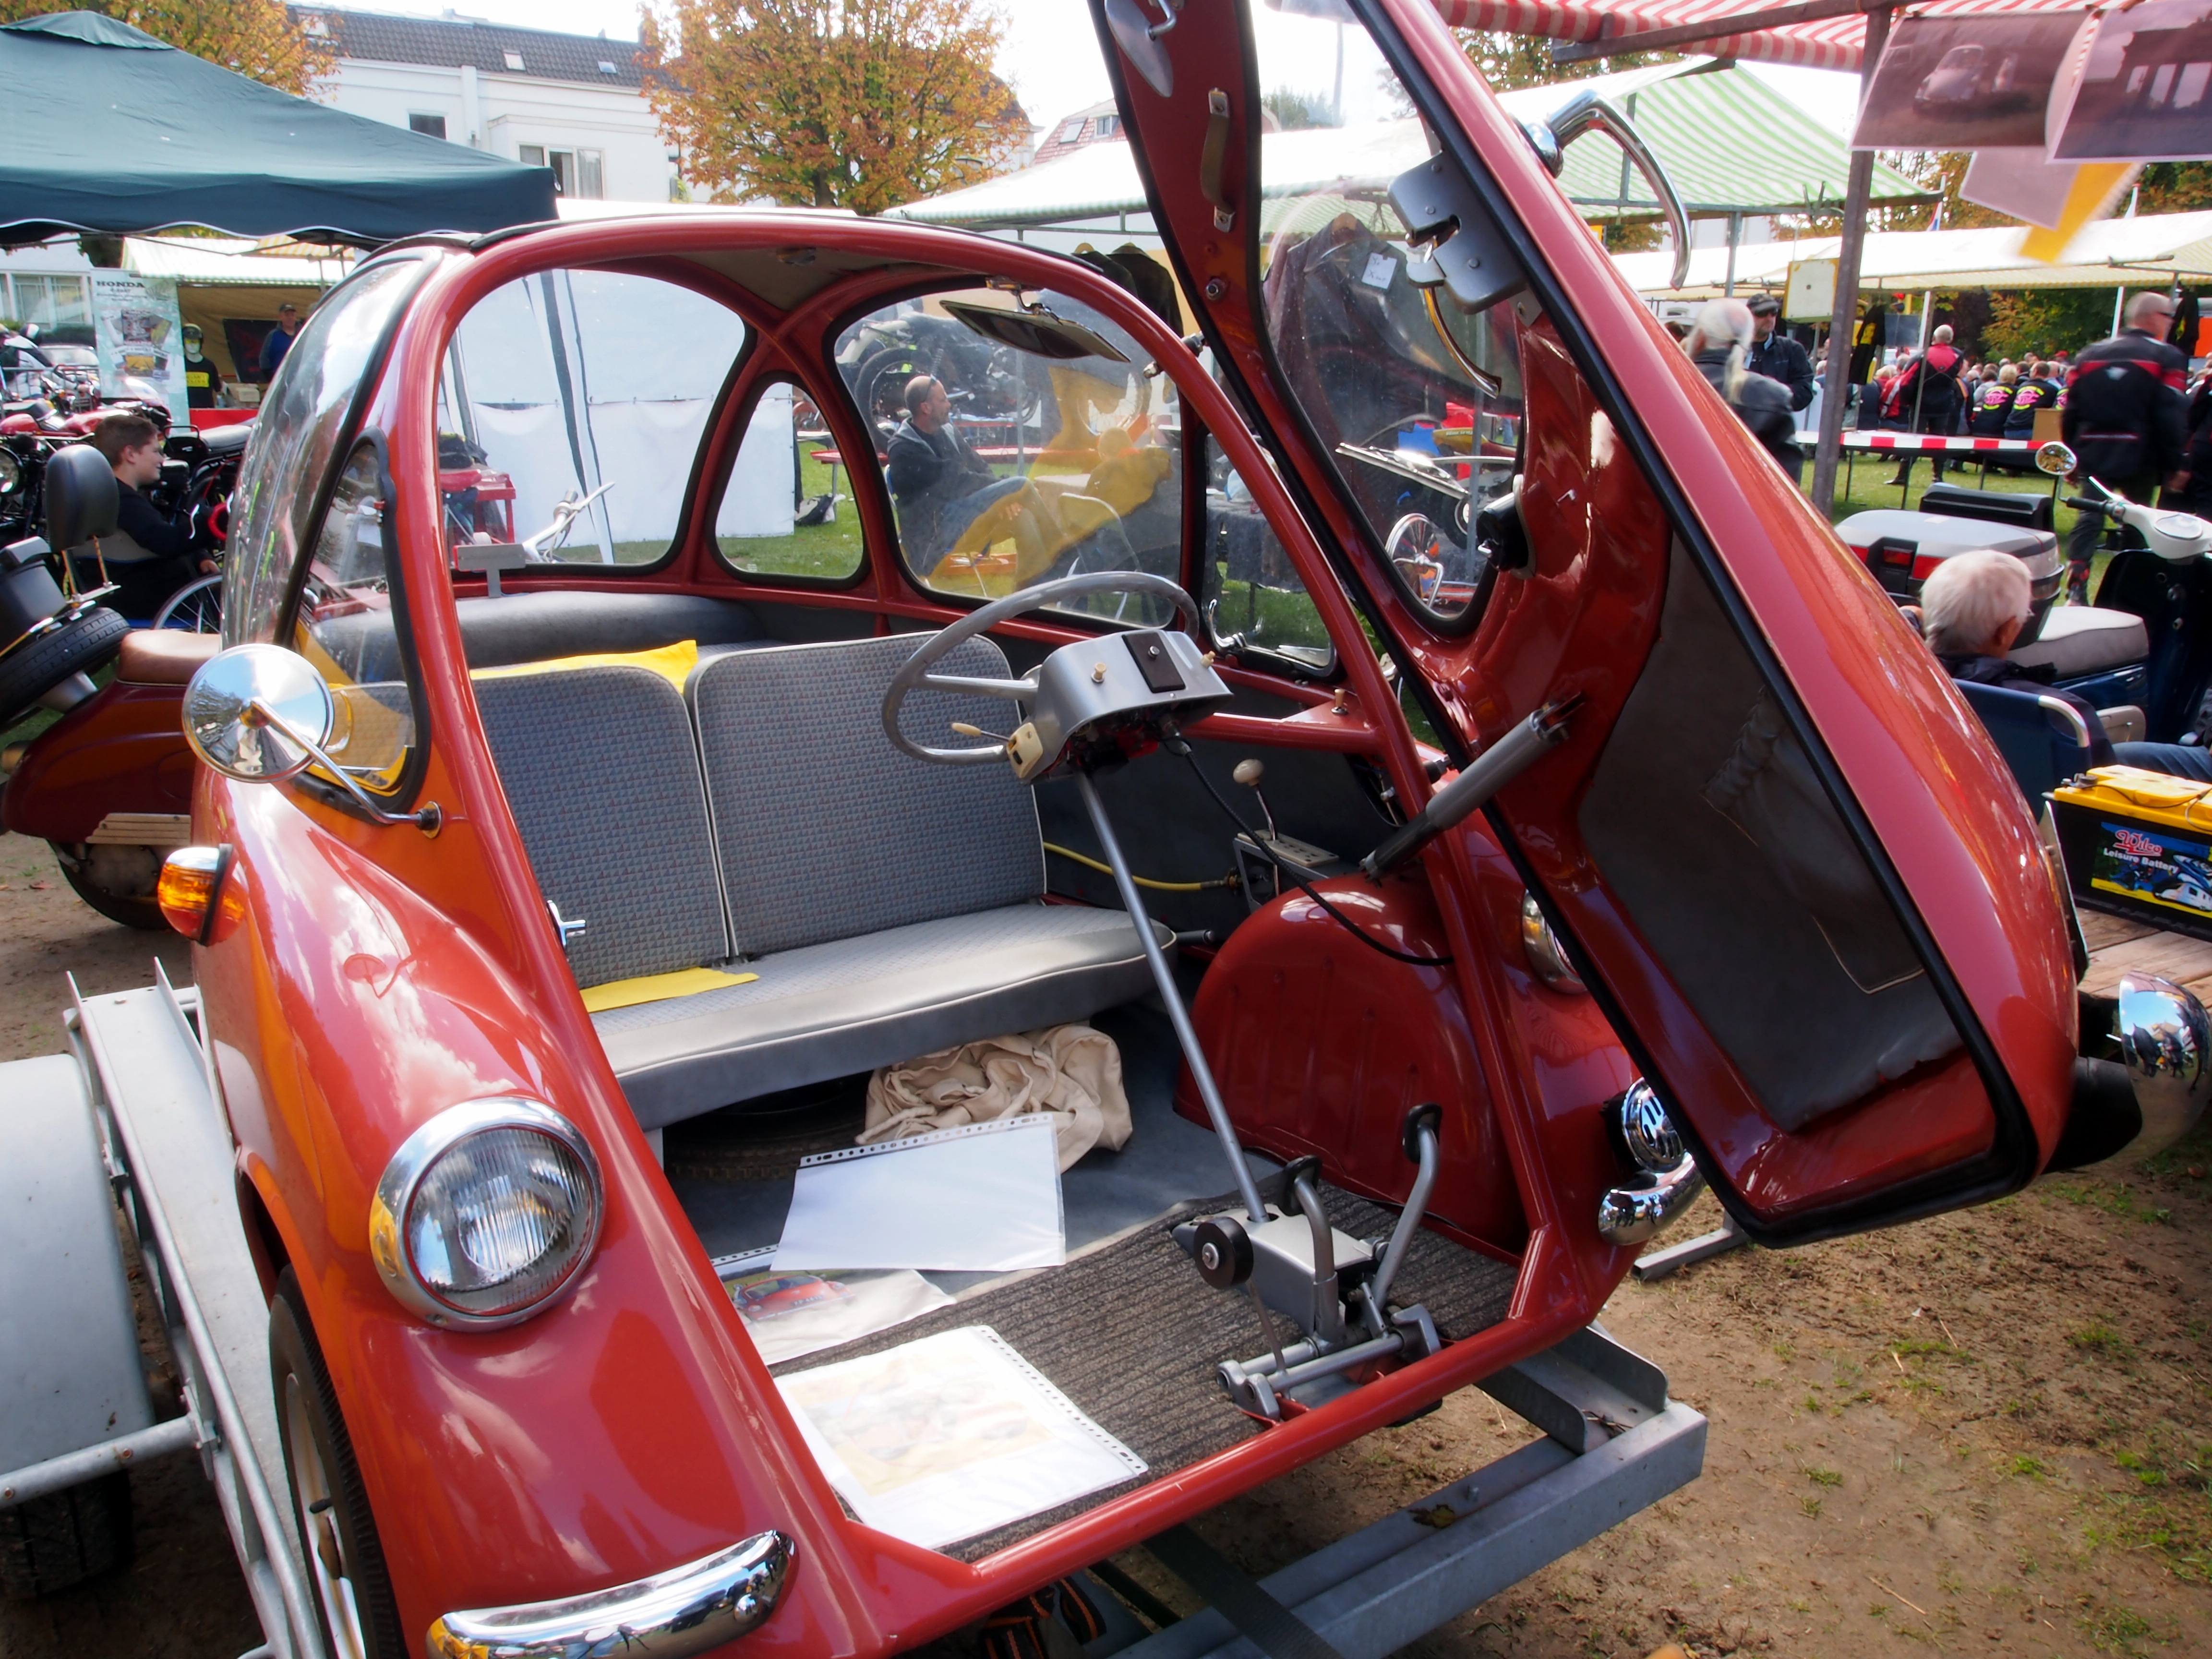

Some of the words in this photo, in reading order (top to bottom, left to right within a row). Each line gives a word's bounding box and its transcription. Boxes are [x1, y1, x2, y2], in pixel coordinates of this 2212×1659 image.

[2115, 830, 2162, 853] Wilco
[2104, 848, 2139, 862] Leisure
[2141, 857, 2178, 874] Battery
